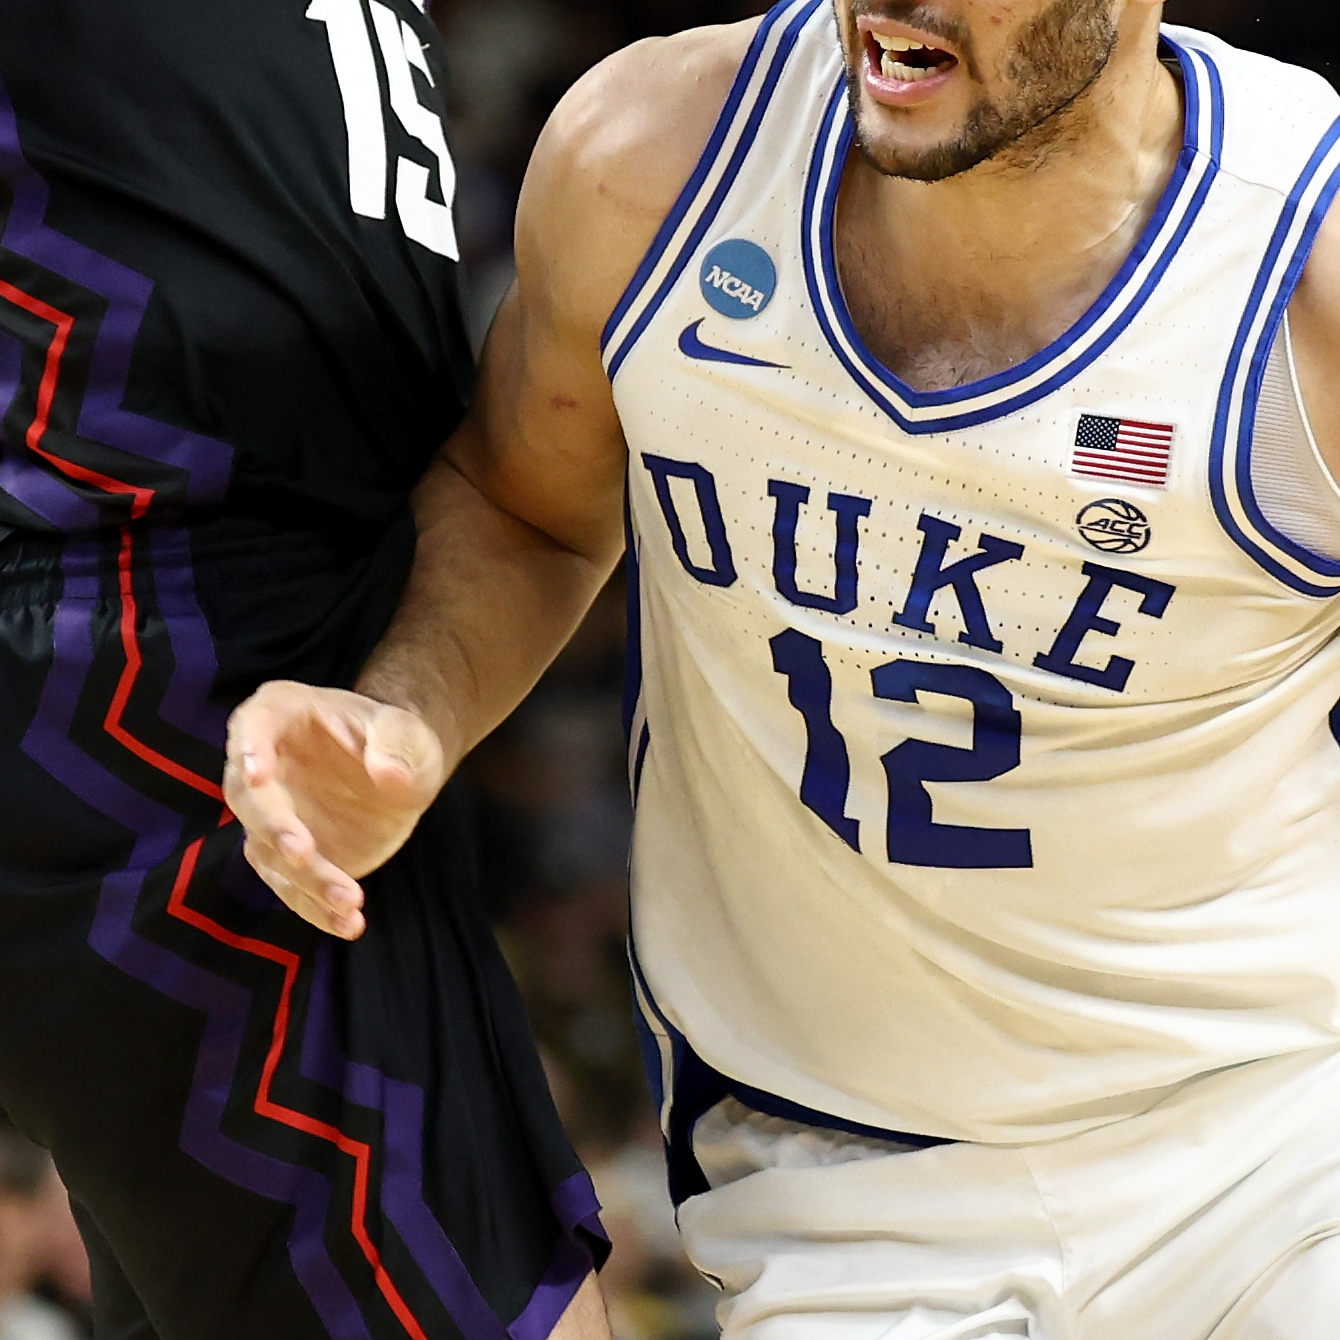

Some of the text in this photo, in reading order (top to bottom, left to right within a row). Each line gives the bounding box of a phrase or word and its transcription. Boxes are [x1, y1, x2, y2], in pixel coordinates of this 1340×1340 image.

[704, 264, 766, 312] NCAA
[642, 452, 1176, 693] DUKE
[1085, 517, 1149, 537] ACC
[768, 627, 1034, 869] 12
